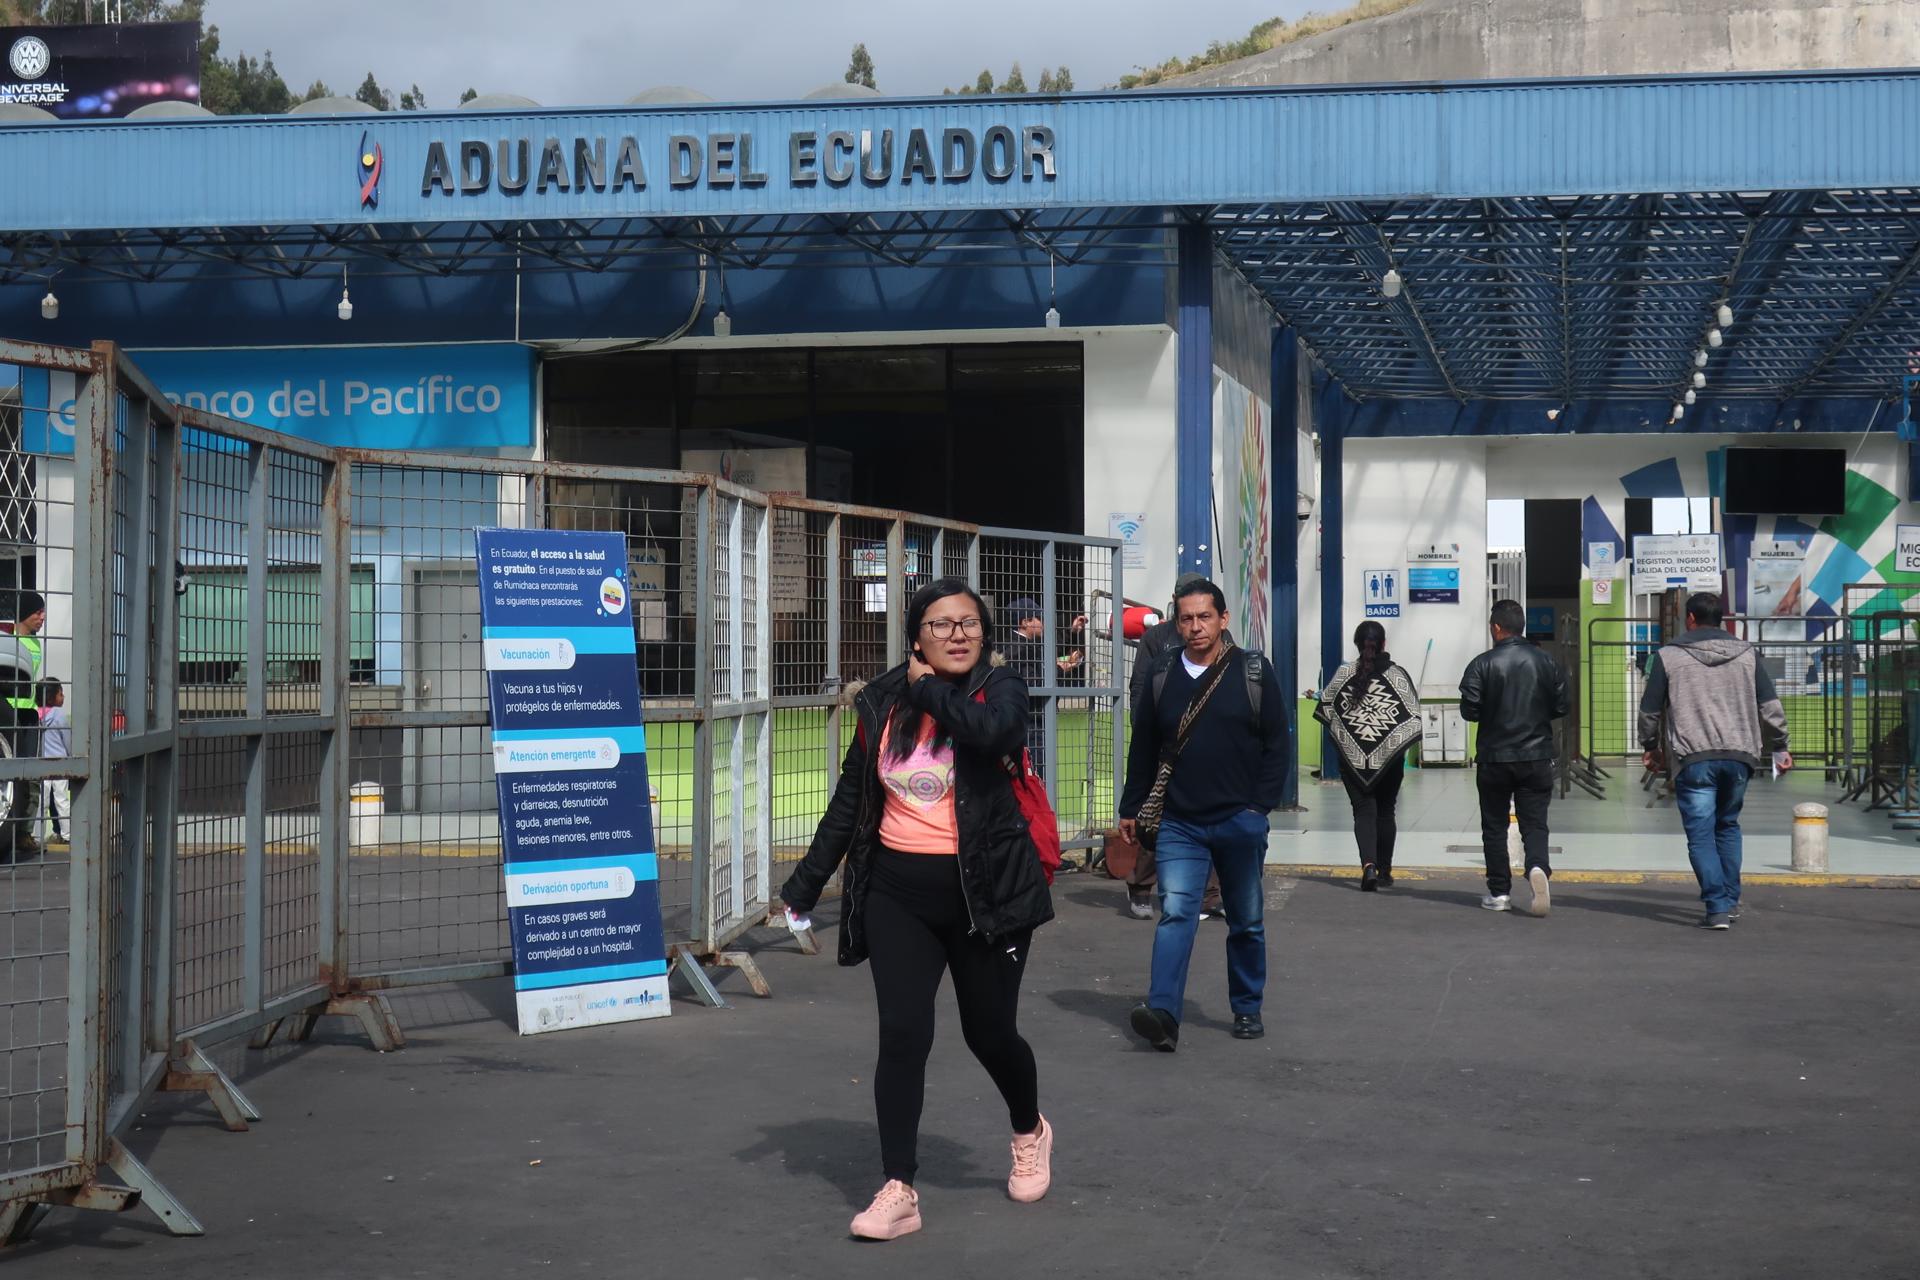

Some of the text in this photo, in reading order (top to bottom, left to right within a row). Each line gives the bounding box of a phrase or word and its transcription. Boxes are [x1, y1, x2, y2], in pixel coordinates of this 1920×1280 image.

[0, 83, 70, 94] NIVERSAL
[0, 93, 65, 104] BEVERAGE
[421, 125, 1056, 197] ADUANA DEL ECUADOR
[163, 374, 501, 419] nco del Pacífico
[490, 548, 606, 561] En Ecuador, el acceso a la salud
[1677, 556, 1711, 564] INGRESO
[1712, 556, 1717, 564] Y
[492, 564, 603, 577] es gratuito. En el puesto de salud
[1636, 565, 1717, 574] SALIDA DEL ECUADOR
[493, 580, 579, 591] de Rumichaca encontrarás
[494, 595, 584, 607] las siguientes prestaciones:
[1366, 605, 1399, 616] BAÑOS
[500, 647, 550, 660] Vacunación
[503, 682, 583, 696] Vacuna a tus hijos y
[505, 699, 623, 714] protégelos de enfermedades.
[509, 749, 597, 762] Atención emergente
[512, 778, 617, 794] Enfermedades respiratorias
[513, 796, 609, 813] y diarreicas, desnutrición
[515, 814, 592, 831] aguda, anemia leve,
[517, 829, 633, 846] lesiones menores, entre otros.
[522, 880, 609, 896] Derivación oportuna
[524, 907, 607, 926] En casos graves será
[526, 923, 642, 943] derivado a un centro de mayor
[527, 939, 634, 961] complejidad o a un hospital.
